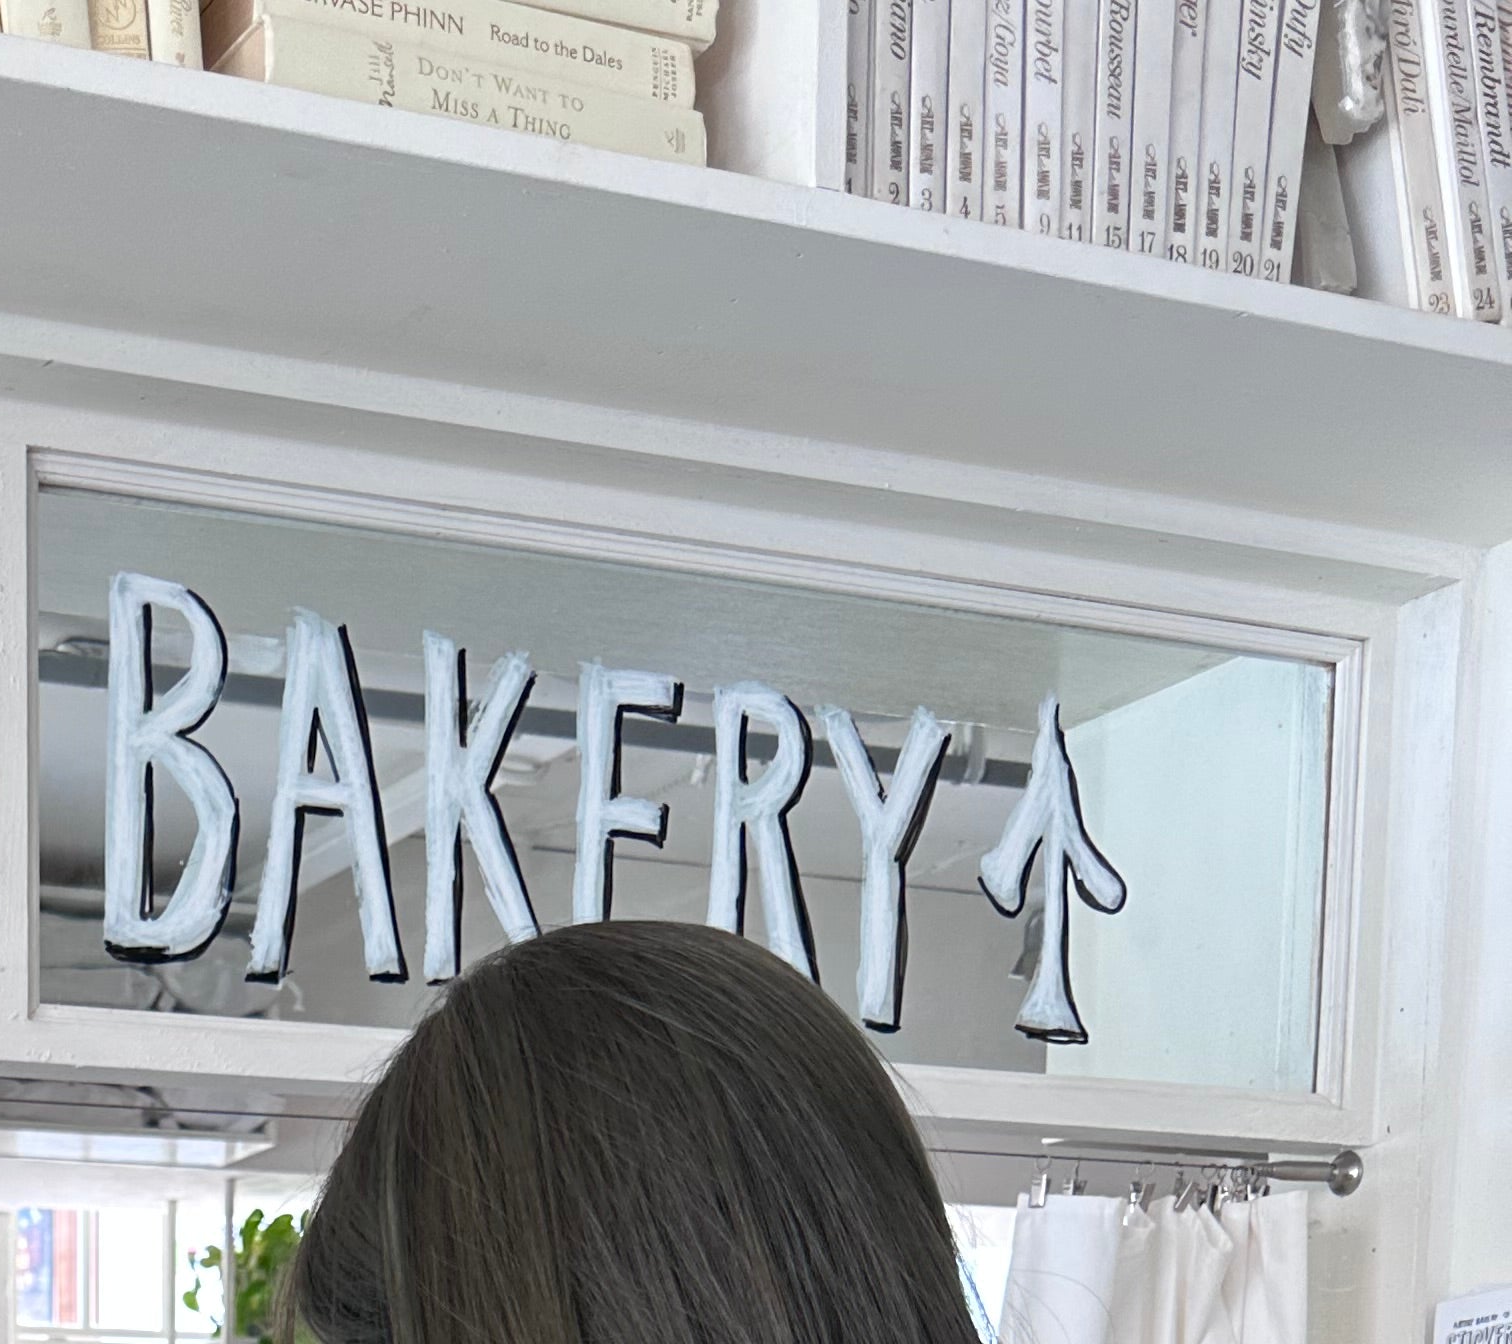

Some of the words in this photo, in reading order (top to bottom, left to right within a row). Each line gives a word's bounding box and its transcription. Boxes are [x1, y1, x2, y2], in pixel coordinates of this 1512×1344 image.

[391, 4, 465, 36] PHINN
[489, 24, 530, 50] Road
[534, 37, 550, 54] to
[553, 39, 579, 61] the
[581, 45, 624, 71] Dales
[417, 56, 485, 89] DON'T
[489, 73, 551, 105] WANT
[558, 93, 586, 113] TO
[431, 87, 481, 120] MISS
[508, 105, 573, 140] THING
[889, 182, 901, 205] 2
[921, 188, 933, 211] 3
[960, 196, 971, 219] 4
[1104, 224, 1123, 249] 15
[1138, 231, 1156, 254] 17
[1167, 244, 1188, 264] 18
[1201, 248, 1220, 270] 19
[1232, 252, 1255, 277] 20
[1264, 258, 1283, 282] 21
[1429, 292, 1451, 315] 23
[1473, 286, 1495, 311] 24
[104, 573, 952, 1033] BAKERY
